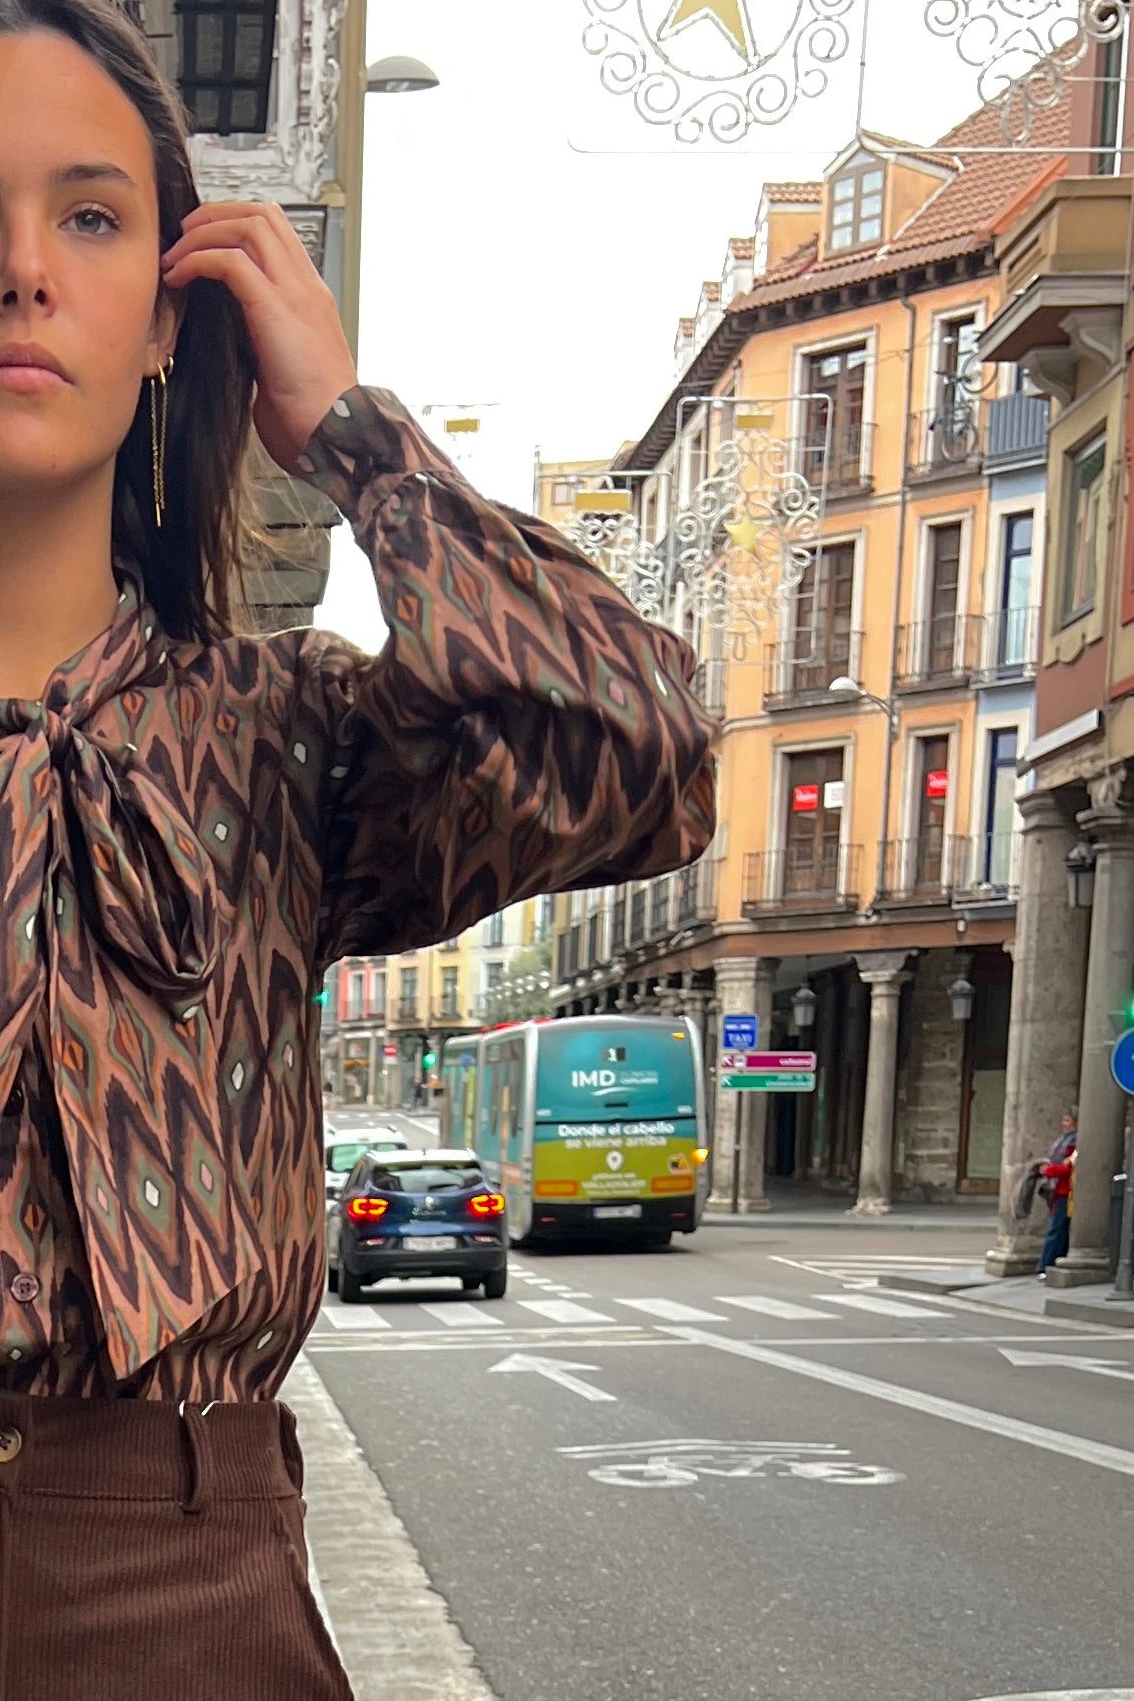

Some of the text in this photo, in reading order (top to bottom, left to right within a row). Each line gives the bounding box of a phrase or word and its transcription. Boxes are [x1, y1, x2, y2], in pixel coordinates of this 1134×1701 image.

[571, 1070, 616, 1087] IMD
[558, 1121, 675, 1137] Donde el cabello
[625, 1136, 667, 1148] arriba
